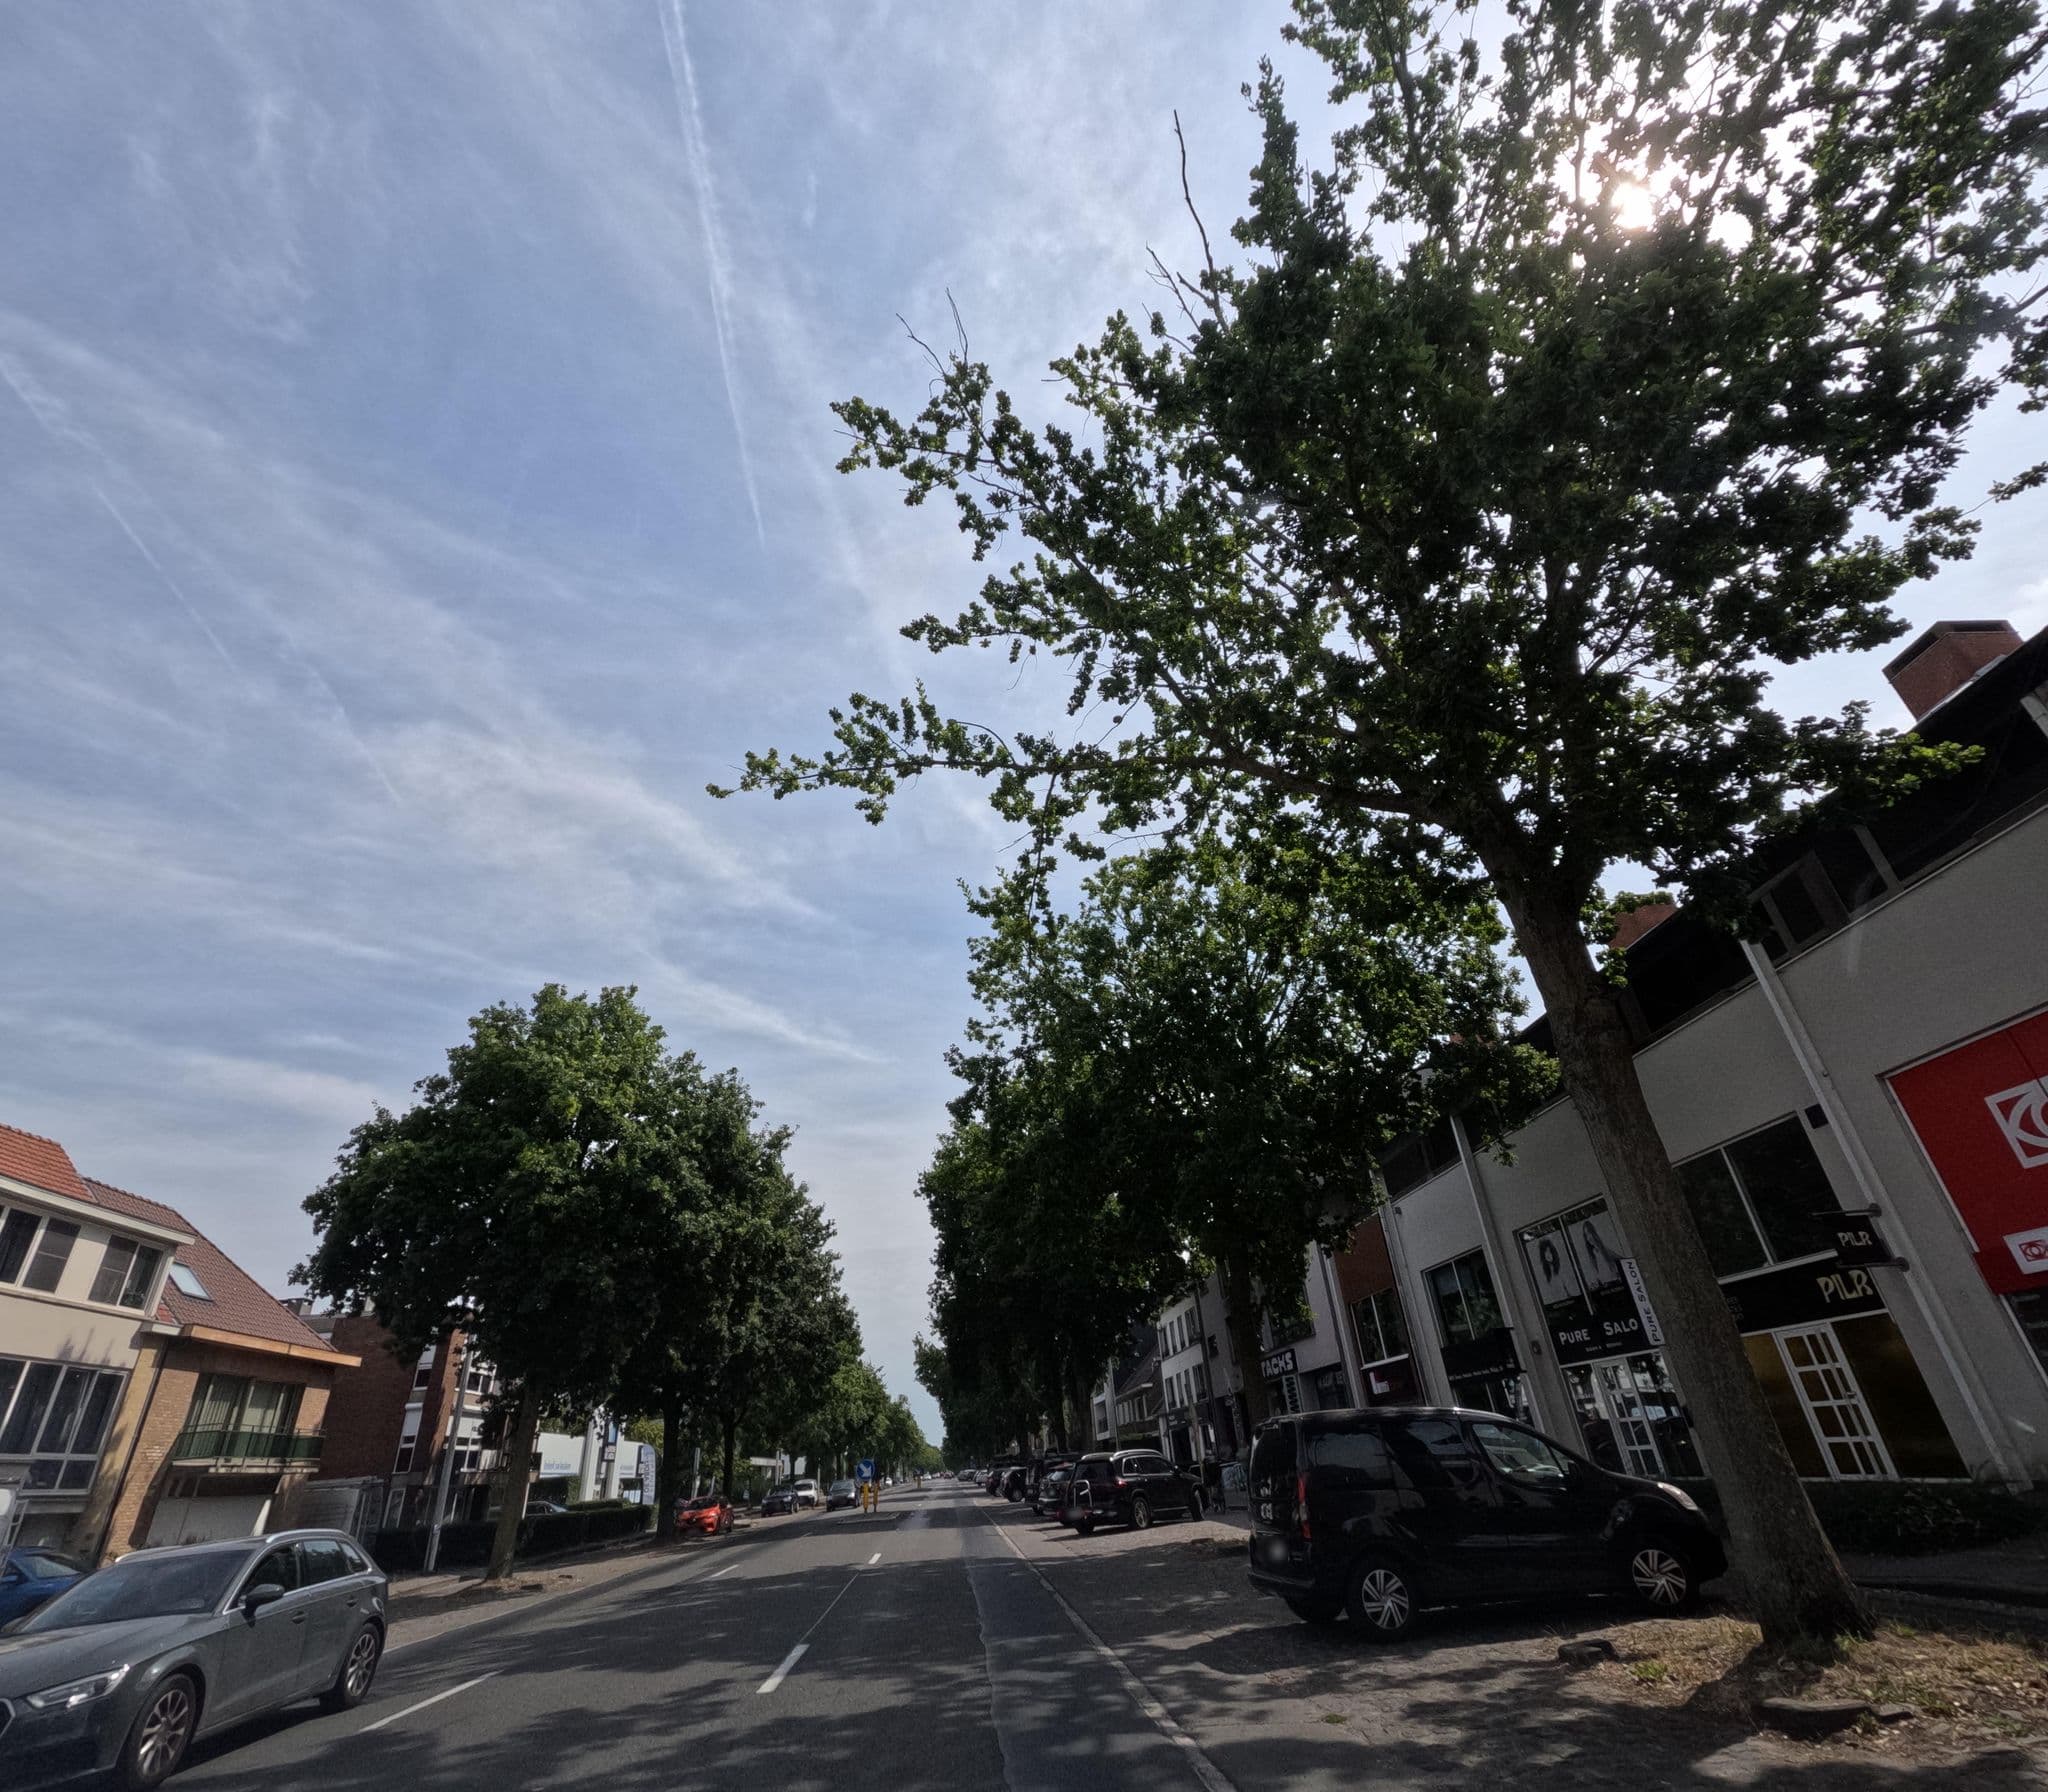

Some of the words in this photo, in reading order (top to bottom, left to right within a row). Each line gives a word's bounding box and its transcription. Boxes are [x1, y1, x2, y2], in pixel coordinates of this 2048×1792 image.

[1625, 1260, 1646, 1303] SALON
[1558, 1328, 1591, 1345] PURE
[1602, 1318, 1638, 1336] SALO
[1643, 1307, 1661, 1342] PURE
